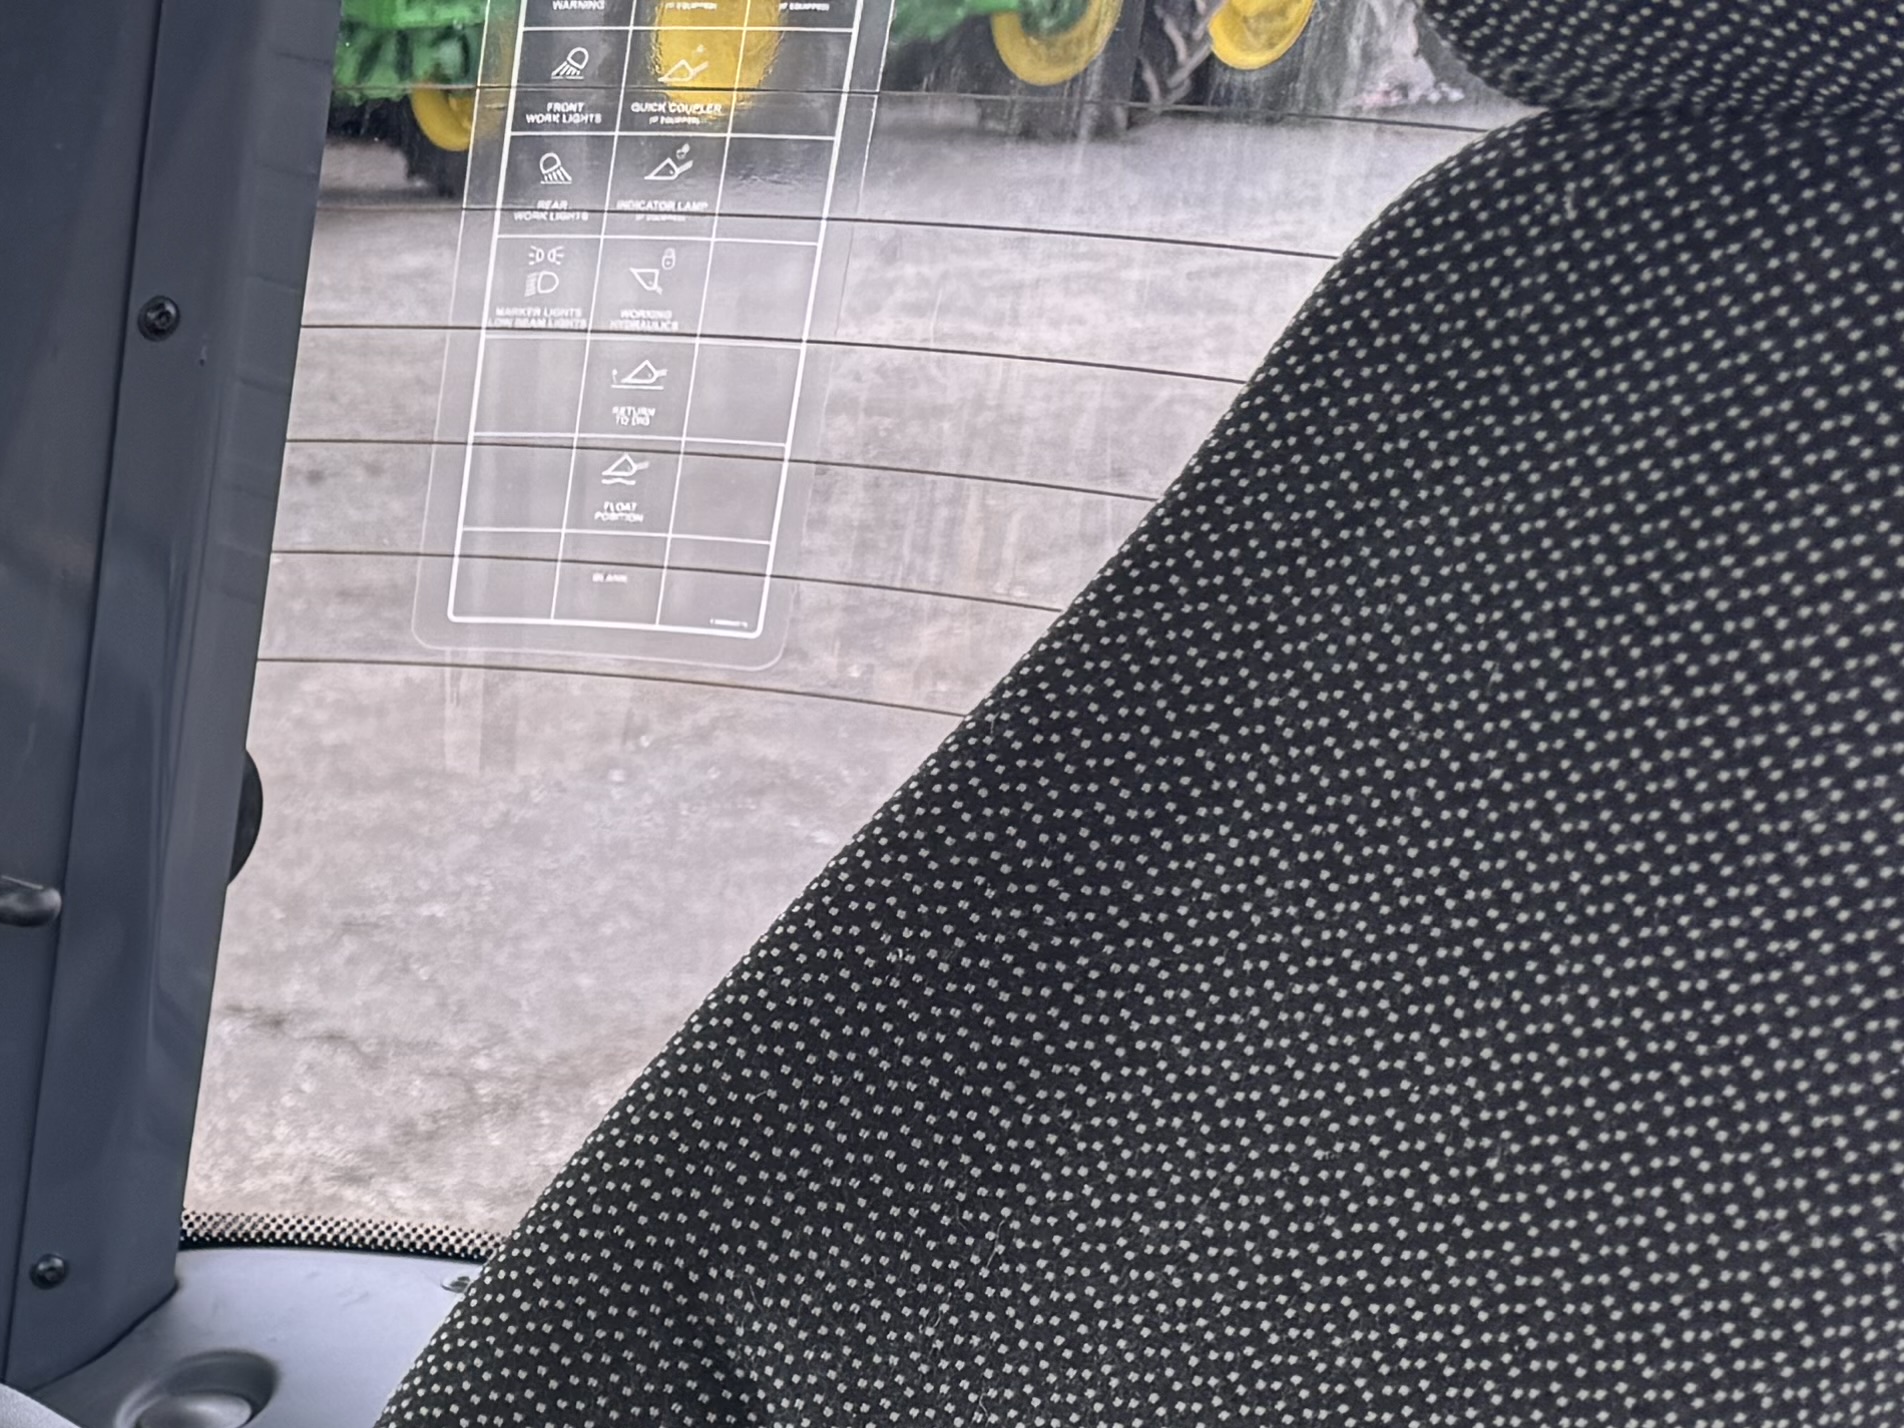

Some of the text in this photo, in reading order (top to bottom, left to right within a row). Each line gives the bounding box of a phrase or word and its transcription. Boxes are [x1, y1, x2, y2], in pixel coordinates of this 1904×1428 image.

[546, 102, 586, 112] FRONT
[630, 102, 722, 115] QUICK COUPLER
[526, 113, 602, 124] WORK LIGHTS
[537, 200, 568, 210] REAR
[616, 200, 709, 212] INDICATOR LAMP
[513, 211, 589, 222] WORK LIGHTS
[495, 306, 582, 318] MARKER LIGHTS
[612, 406, 656, 417] RETURN
[604, 501, 637, 512] FLOAT
[594, 511, 645, 523] POSITION
